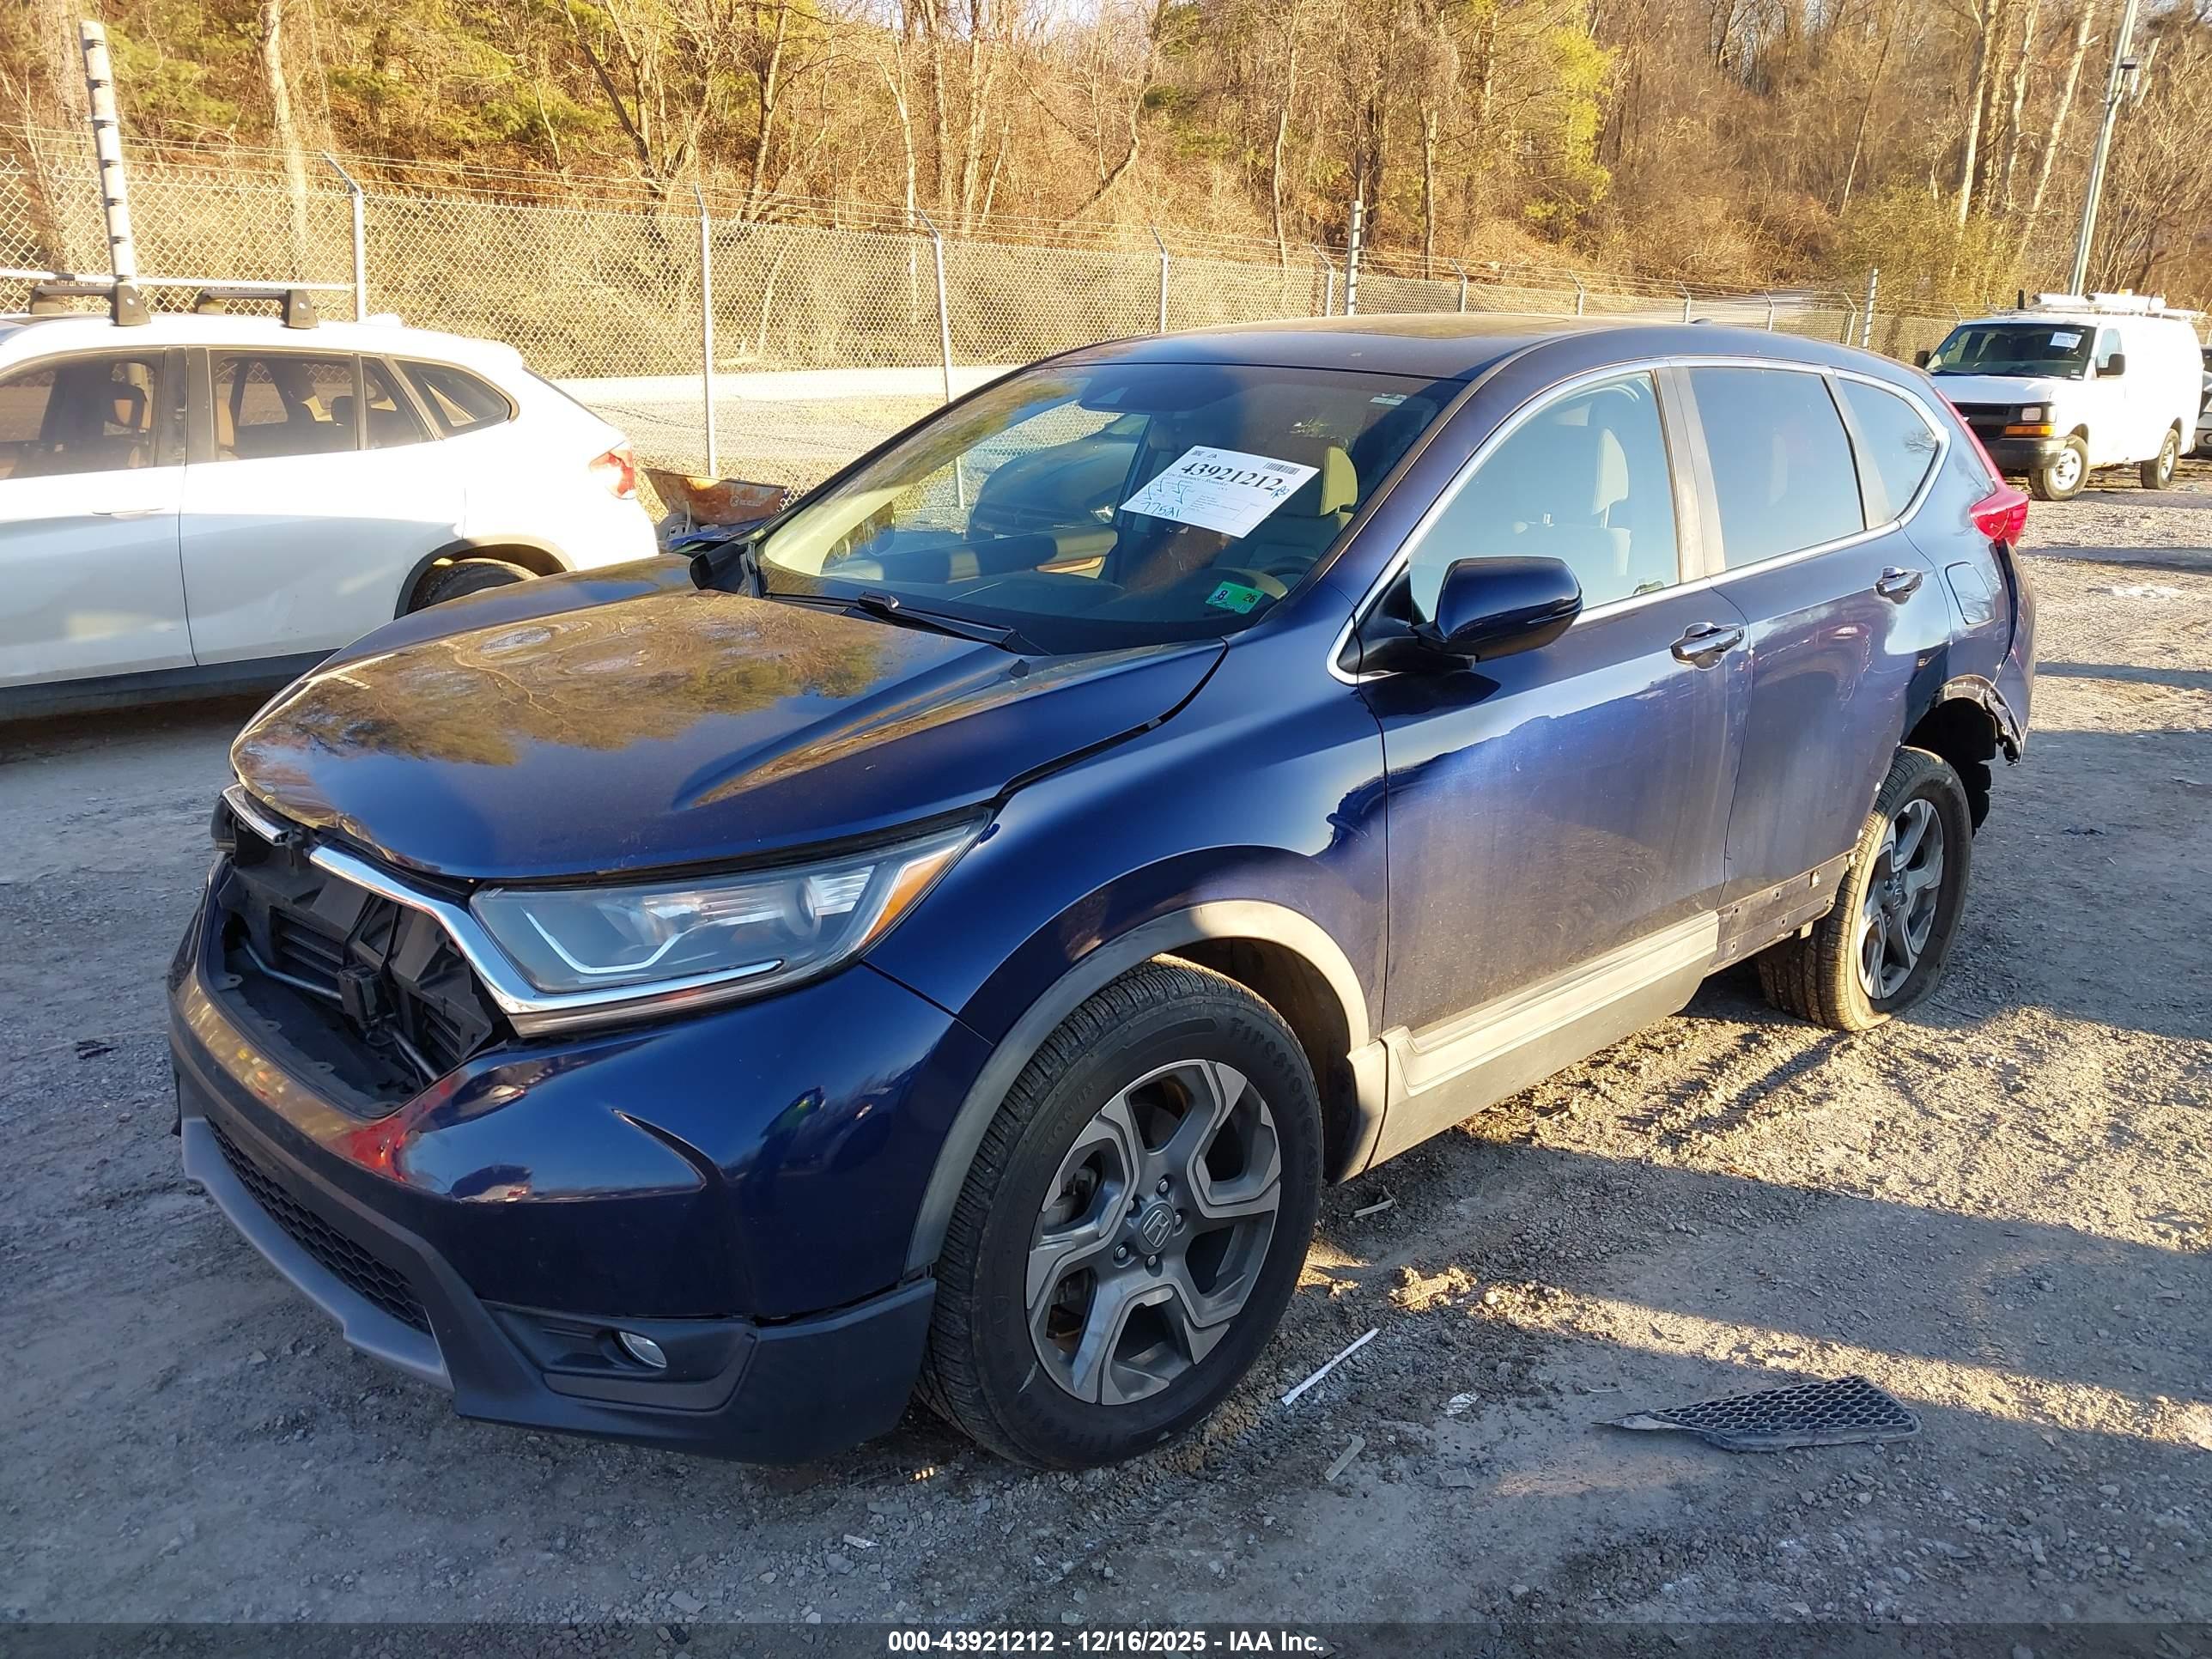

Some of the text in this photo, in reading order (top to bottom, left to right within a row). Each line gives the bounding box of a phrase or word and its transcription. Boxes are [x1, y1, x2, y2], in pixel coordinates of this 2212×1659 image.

[1181, 461, 1284, 492] 43921212
[1217, 589, 1229, 600] 8
[1243, 592, 1258, 604] 26
